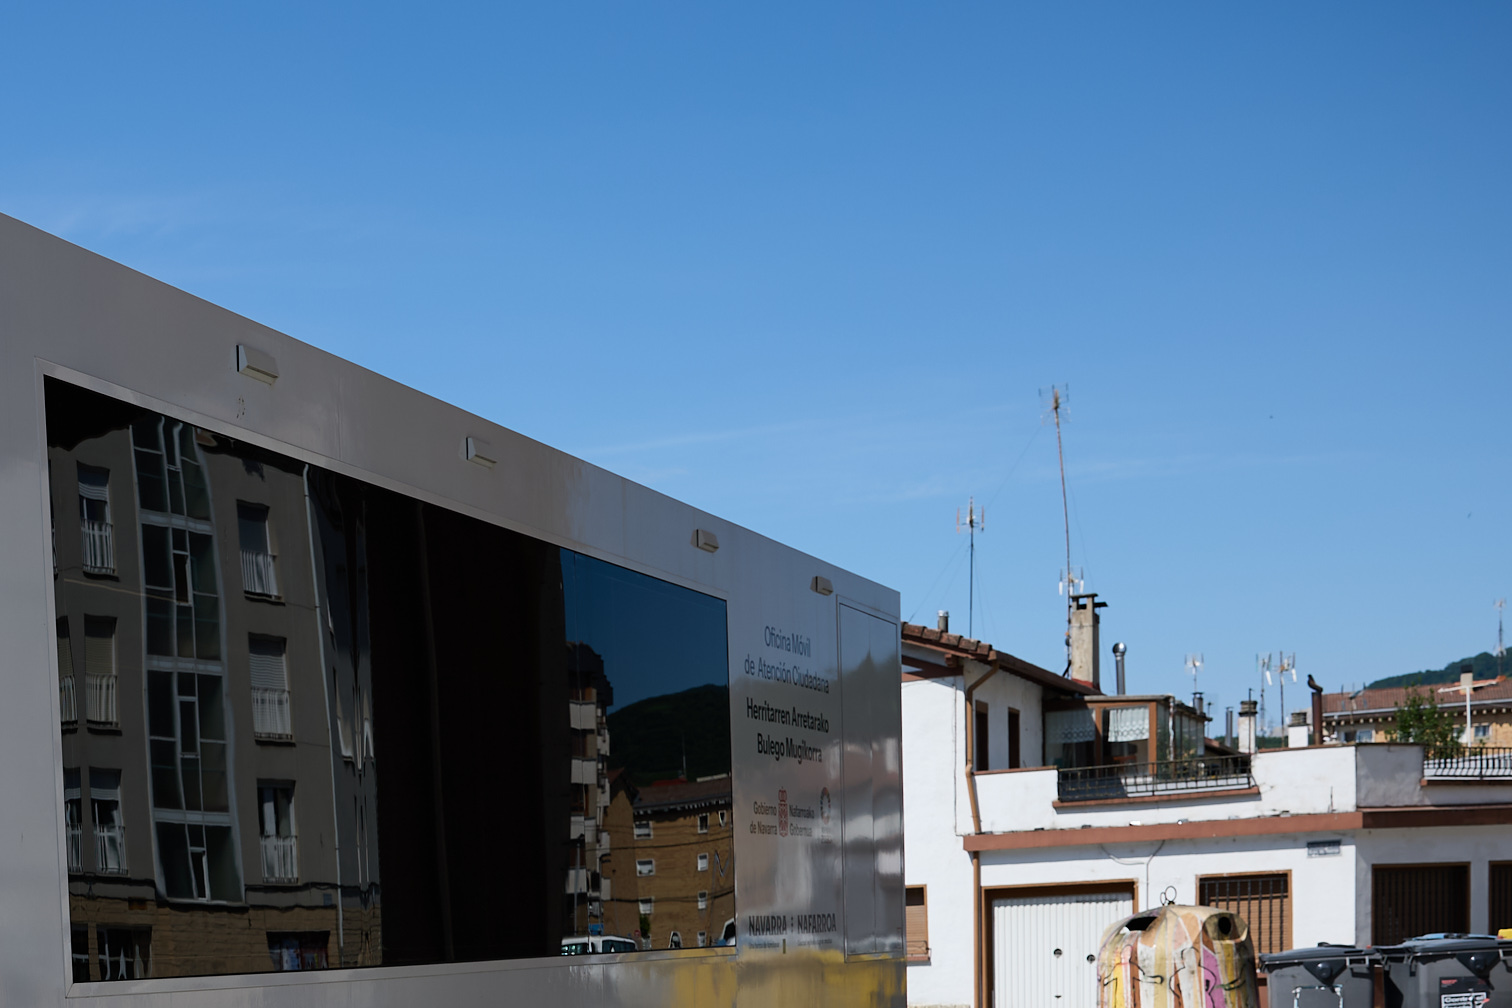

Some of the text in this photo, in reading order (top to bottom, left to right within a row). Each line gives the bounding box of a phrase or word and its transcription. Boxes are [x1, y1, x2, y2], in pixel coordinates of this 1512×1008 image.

[764, 625, 811, 658] Oficina Móvil
[745, 654, 829, 694] de Atención Ciudadana
[747, 697, 829, 733] Herritarren Arretarako
[757, 733, 822, 765] Bulego Mugikorra
[753, 801, 777, 817] Gobierno
[750, 820, 777, 836] de Navarra
[748, 915, 787, 936] NAVARRA
[797, 913, 837, 934] NAFARROA
